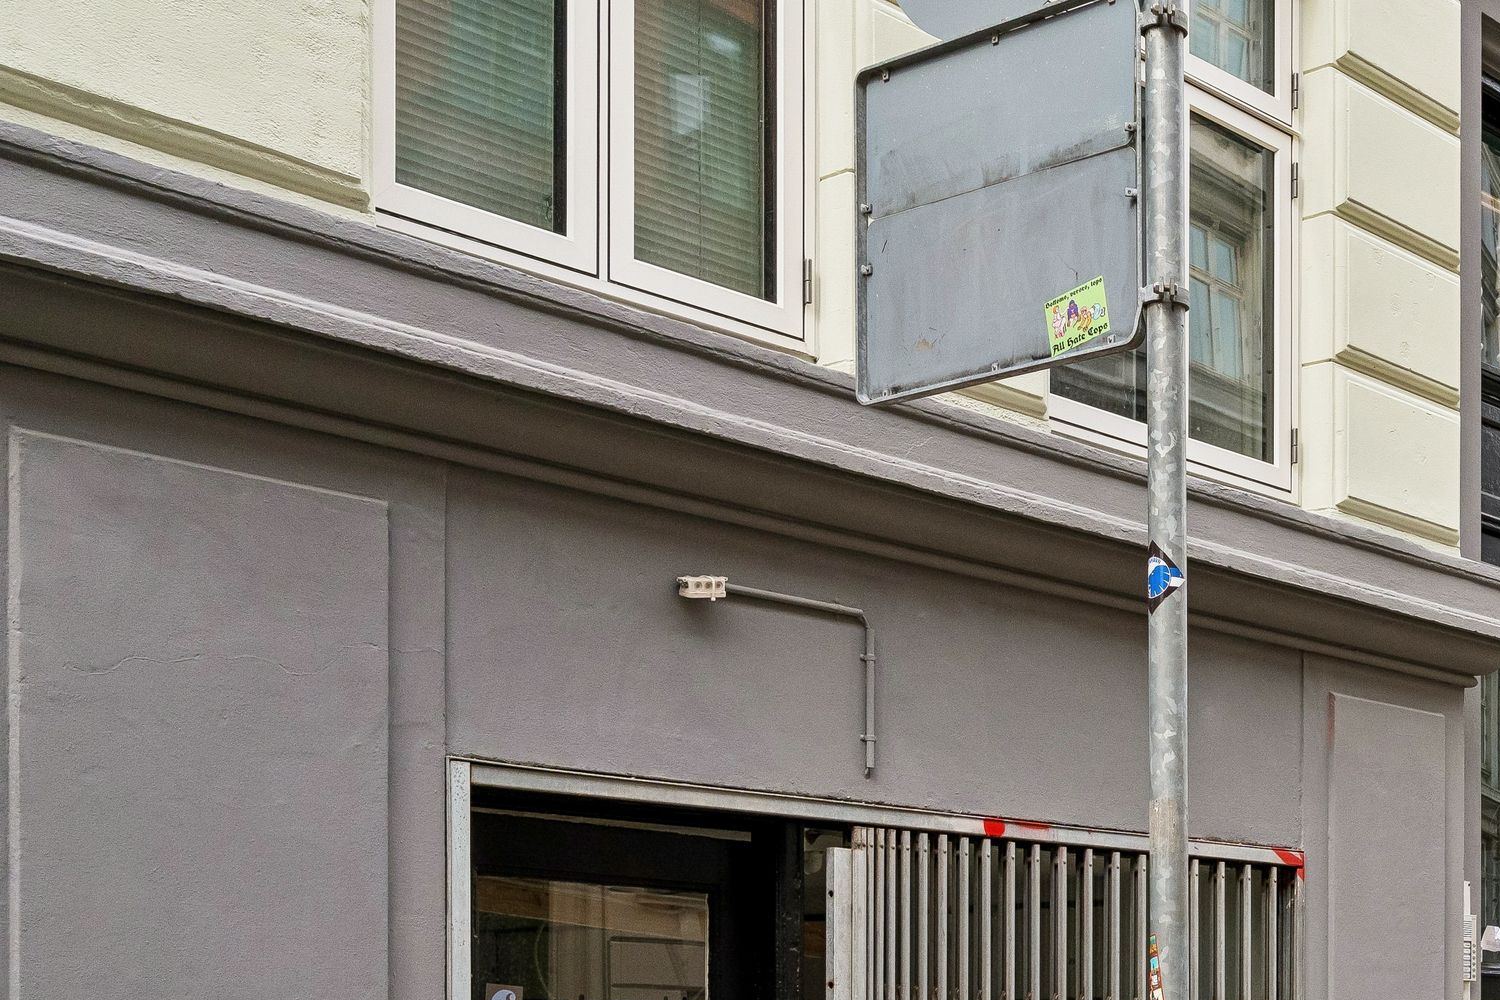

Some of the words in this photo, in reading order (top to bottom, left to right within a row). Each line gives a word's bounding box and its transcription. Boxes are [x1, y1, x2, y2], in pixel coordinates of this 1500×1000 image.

[1052, 341, 1065, 356] All
[1067, 333, 1085, 349] Hate
[1087, 322, 1108, 336] Cops
